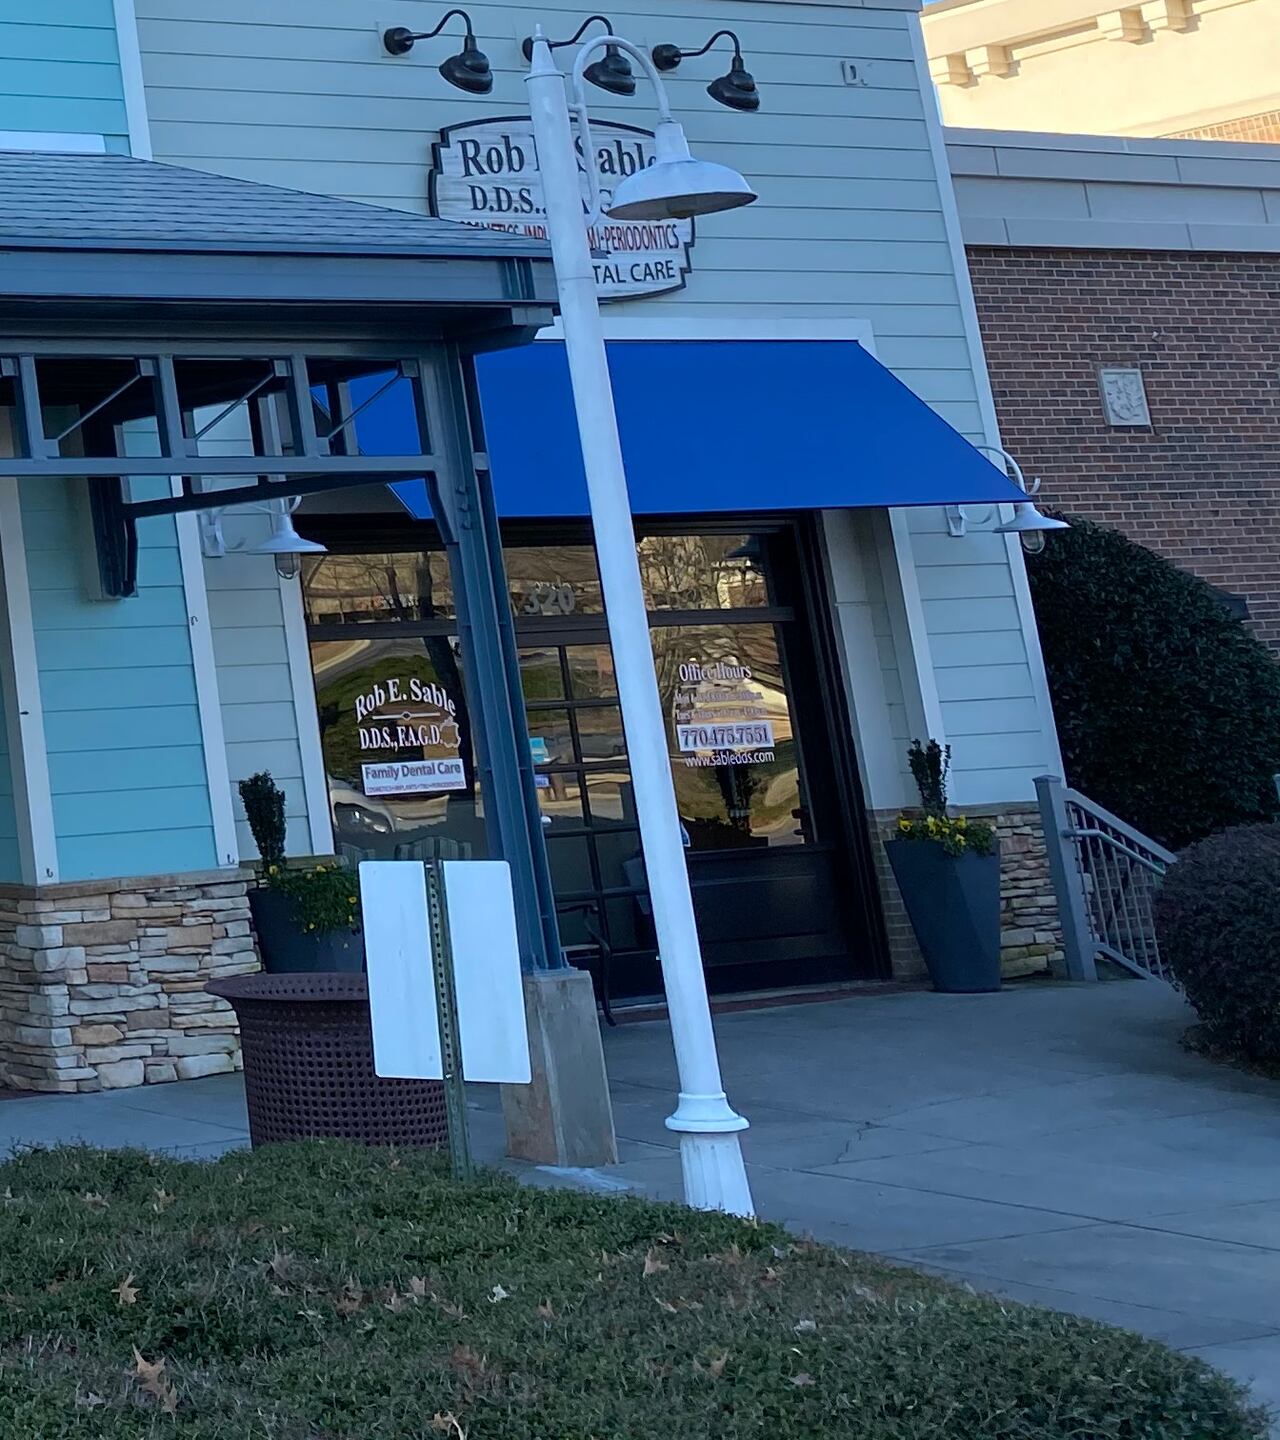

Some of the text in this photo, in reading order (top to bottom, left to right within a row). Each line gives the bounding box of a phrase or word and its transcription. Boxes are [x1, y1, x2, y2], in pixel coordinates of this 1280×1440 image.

[457, 134, 525, 177] Rob
[592, 260, 676, 284] TAL CARE
[354, 678, 457, 724] Rob E. Sable
[365, 762, 461, 781] Family Dental Care
